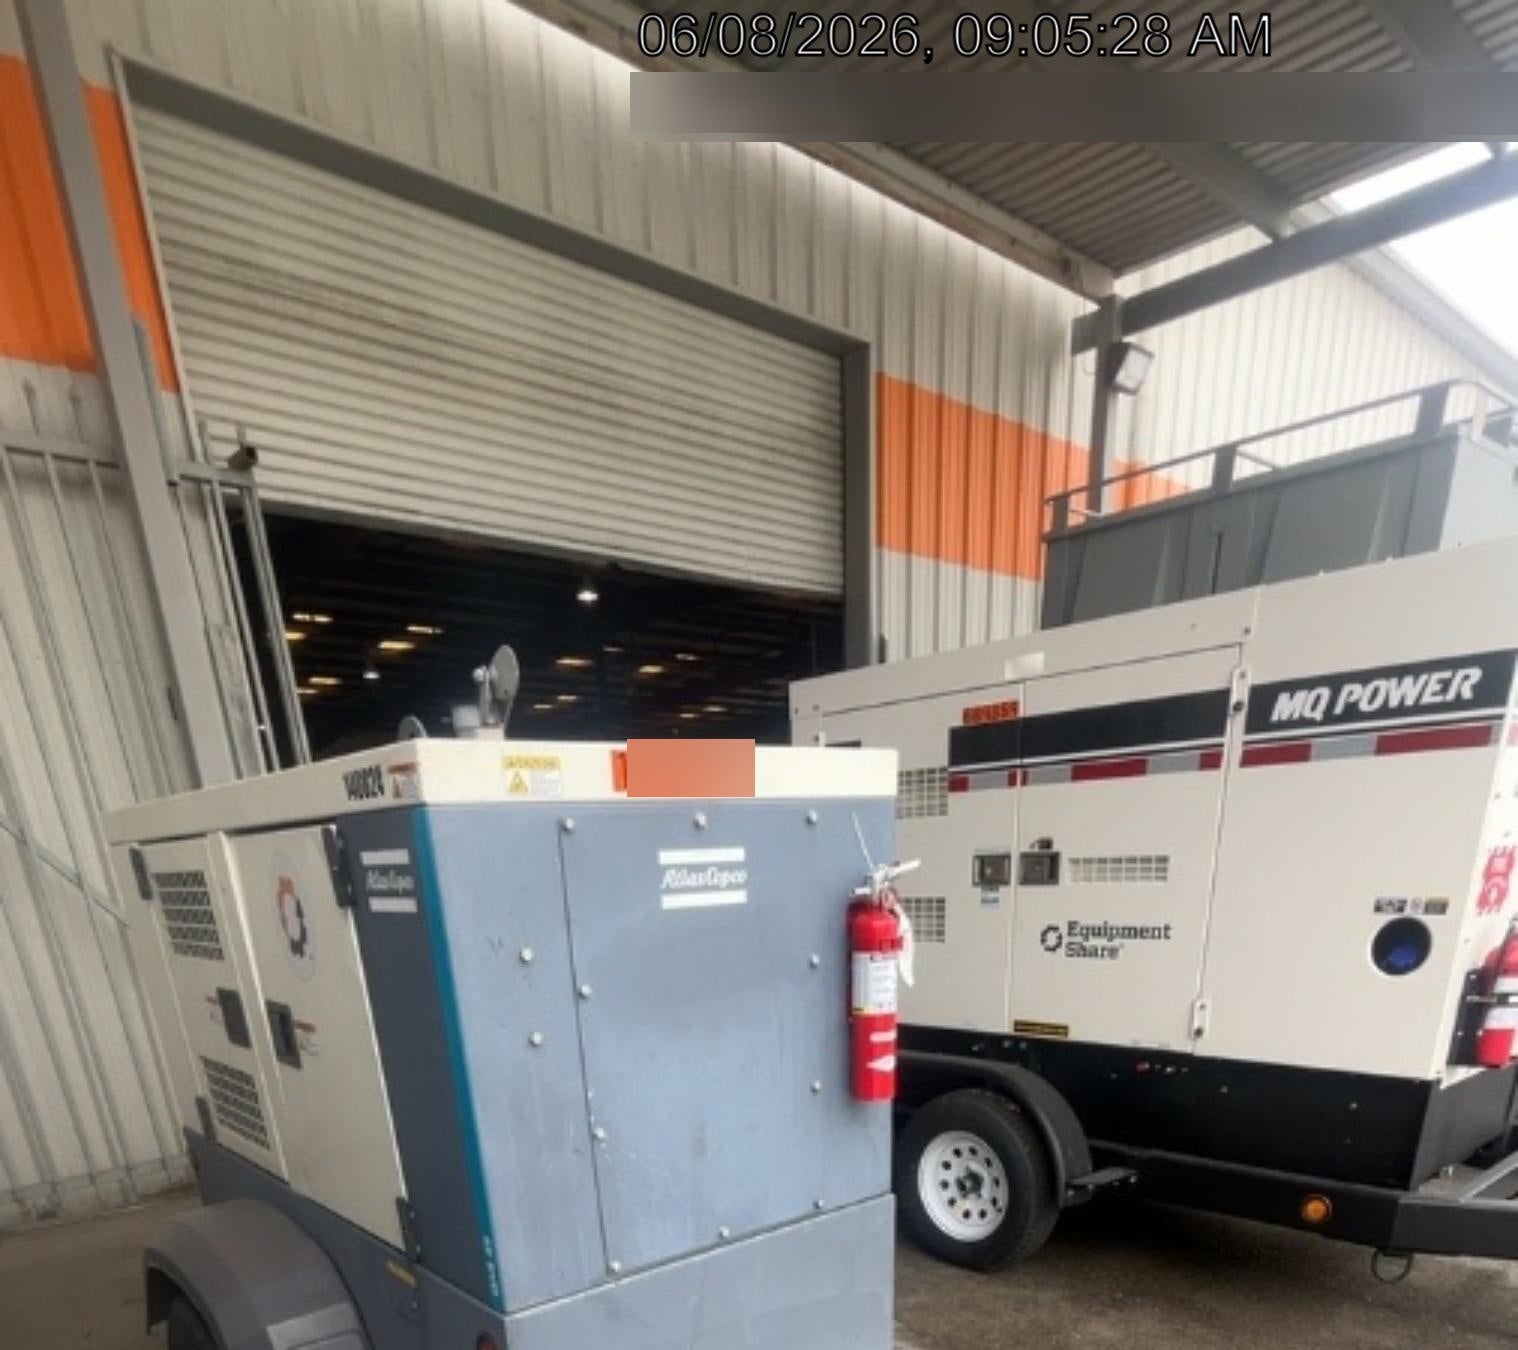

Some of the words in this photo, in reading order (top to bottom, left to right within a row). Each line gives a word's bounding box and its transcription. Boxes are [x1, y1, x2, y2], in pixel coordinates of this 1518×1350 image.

[1271, 686, 1331, 722] MQ
[1332, 666, 1483, 716] POWER
[1067, 919, 1172, 942] Equipment
[1064, 941, 1121, 960] Share
